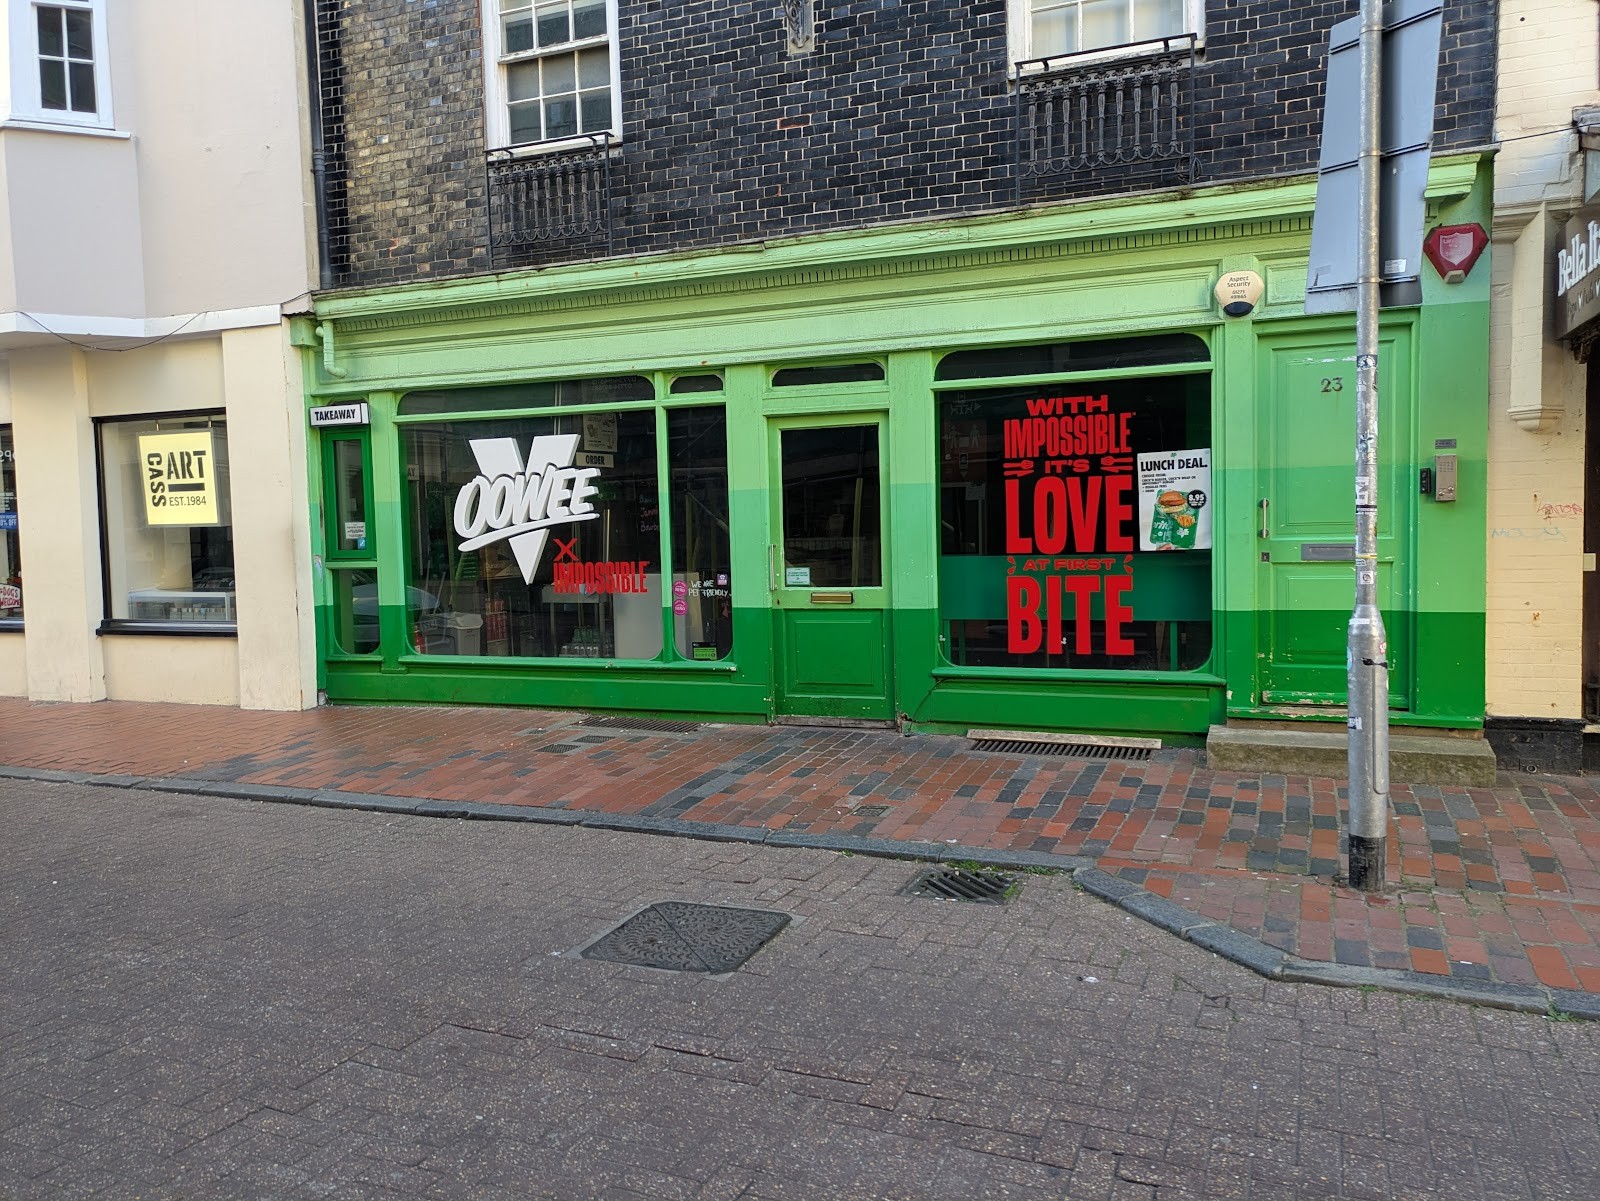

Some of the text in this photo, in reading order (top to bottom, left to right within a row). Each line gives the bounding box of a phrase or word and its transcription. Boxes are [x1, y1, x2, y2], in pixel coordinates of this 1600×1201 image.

[1557, 220, 1600, 297] Bella It
[1321, 377, 1343, 392] 23
[1026, 395, 1108, 416] WITH
[314, 409, 356, 421] TAKEAWAY
[1003, 412, 1136, 459] IMPOSSIBLE
[167, 451, 206, 480] ART
[585, 455, 605, 465] ORDER
[1045, 460, 1090, 474] IT'S
[1140, 457, 1208, 472] LUNCH DEAL.
[147, 453, 167, 507] CASS
[169, 496, 207, 506] EST.1984
[1005, 474, 1134, 556] LOVE
[1023, 558, 1115, 571] AT FIRST
[553, 561, 650, 594] IMPOSSIBLE
[690, 580, 702, 588] WE
[688, 589, 700, 597] PET
[1006, 575, 1135, 656] BITE
